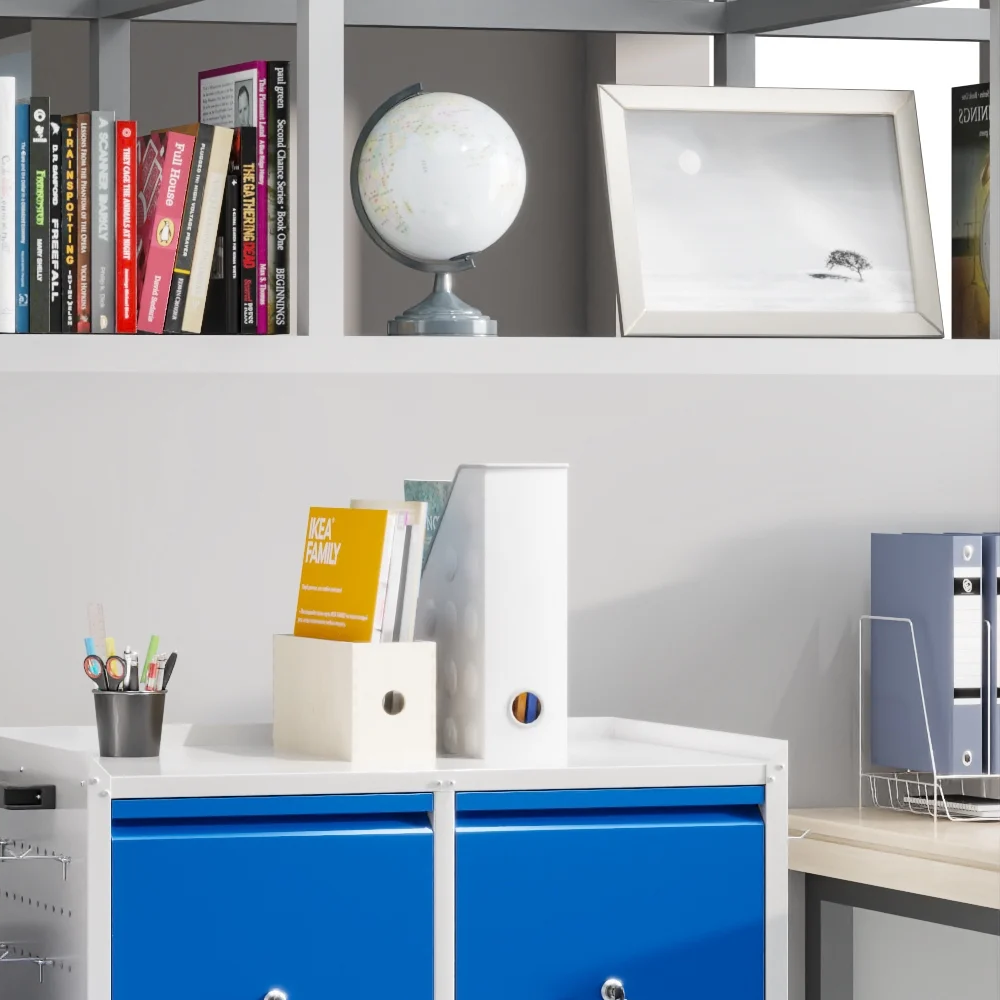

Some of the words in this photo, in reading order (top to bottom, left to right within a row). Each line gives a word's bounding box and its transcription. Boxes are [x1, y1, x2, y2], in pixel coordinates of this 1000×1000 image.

[274, 67, 286, 85] paul
[275, 86, 285, 109] green
[99, 117, 108, 128] A
[277, 119, 286, 148] Second
[99, 132, 108, 190] SCANNER
[172, 142, 185, 165] Full
[277, 150, 286, 179] Chance
[243, 163, 255, 183] THE
[66, 128, 74, 265] TRAINSPOTTING
[166, 168, 181, 207] House
[277, 180, 286, 204] Series
[99, 194, 108, 241] DARKLY
[243, 184, 255, 241] GATHERING
[277, 211, 286, 232] Book
[277, 233, 286, 250] One
[51, 218, 59, 302] FREEFALL
[243, 242, 255, 269] DEAD
[153, 275, 161, 295] David
[276, 268, 285, 325] BEGINNINGS
[308, 517, 332, 540] IKEA
[305, 541, 341, 565] FAMILY
